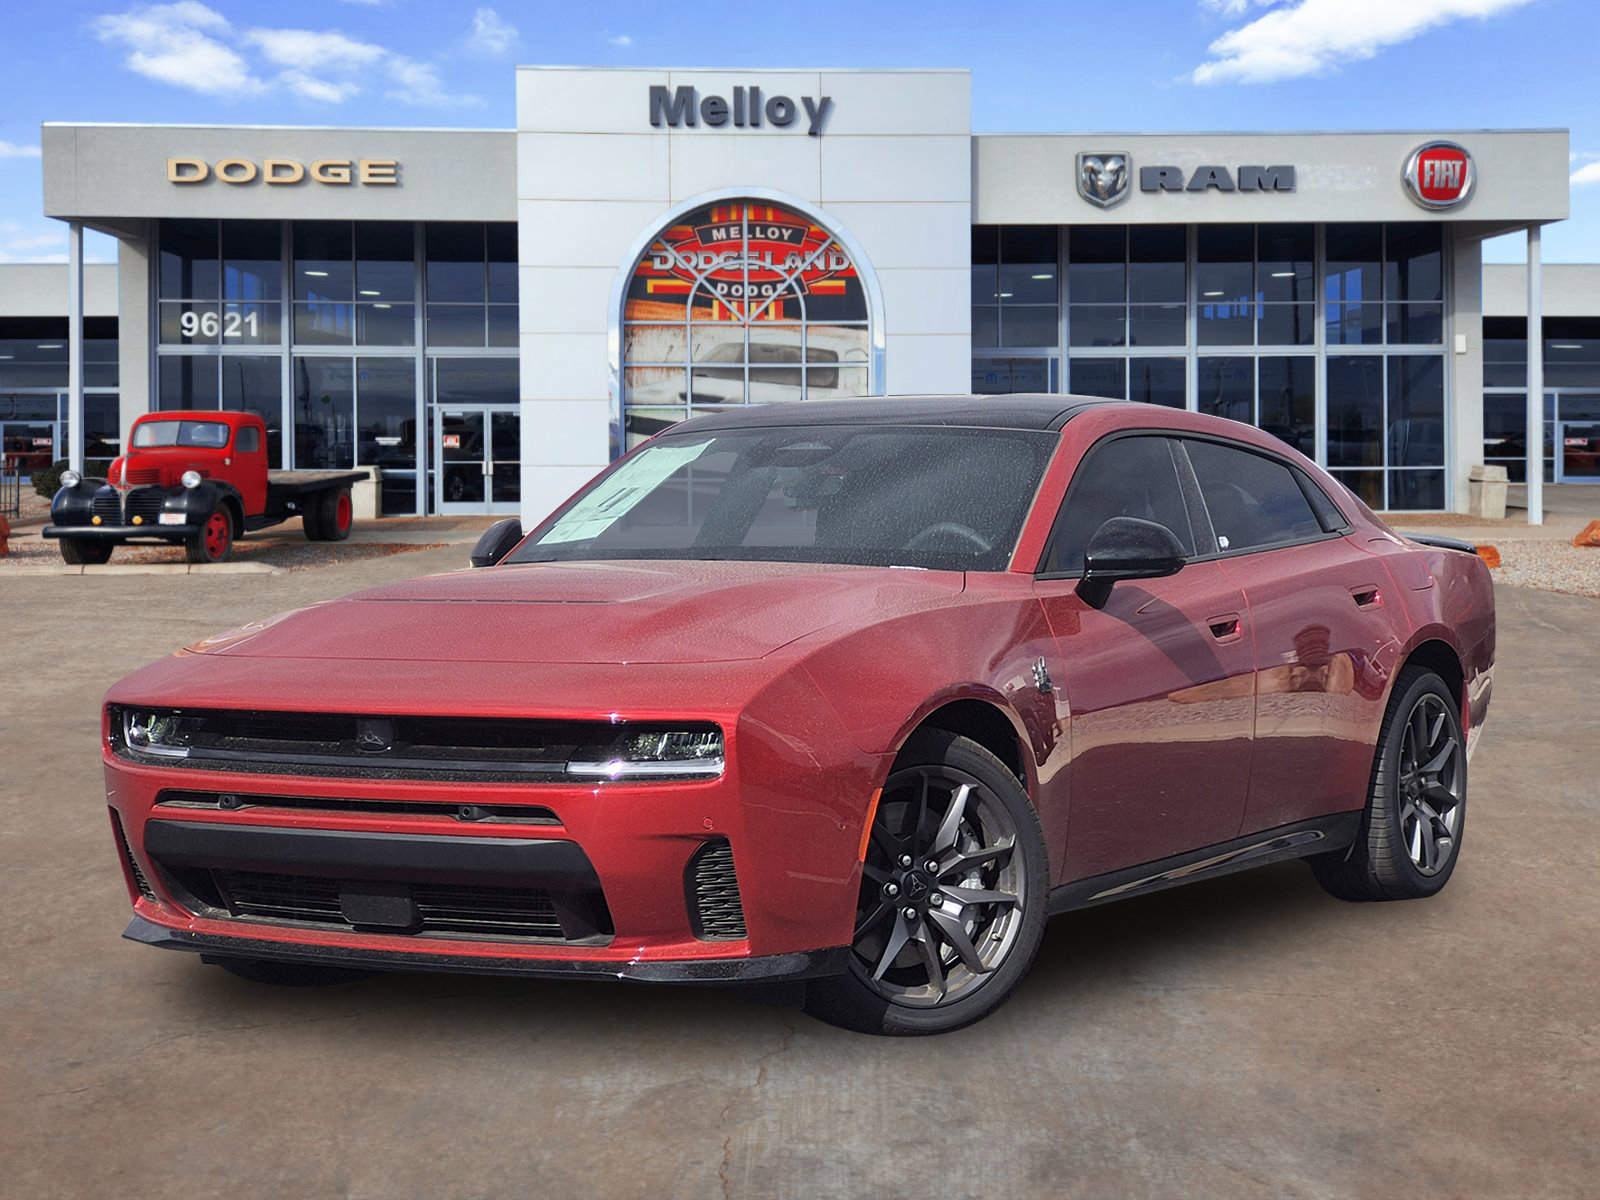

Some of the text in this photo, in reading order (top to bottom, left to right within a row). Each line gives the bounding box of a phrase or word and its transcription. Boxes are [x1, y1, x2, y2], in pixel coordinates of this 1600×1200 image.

[649, 85, 831, 135] Melloy
[167, 159, 398, 184] DODGE
[1140, 165, 1297, 192] RAM
[1424, 160, 1463, 188] FIAT
[181, 312, 257, 337] 9621
